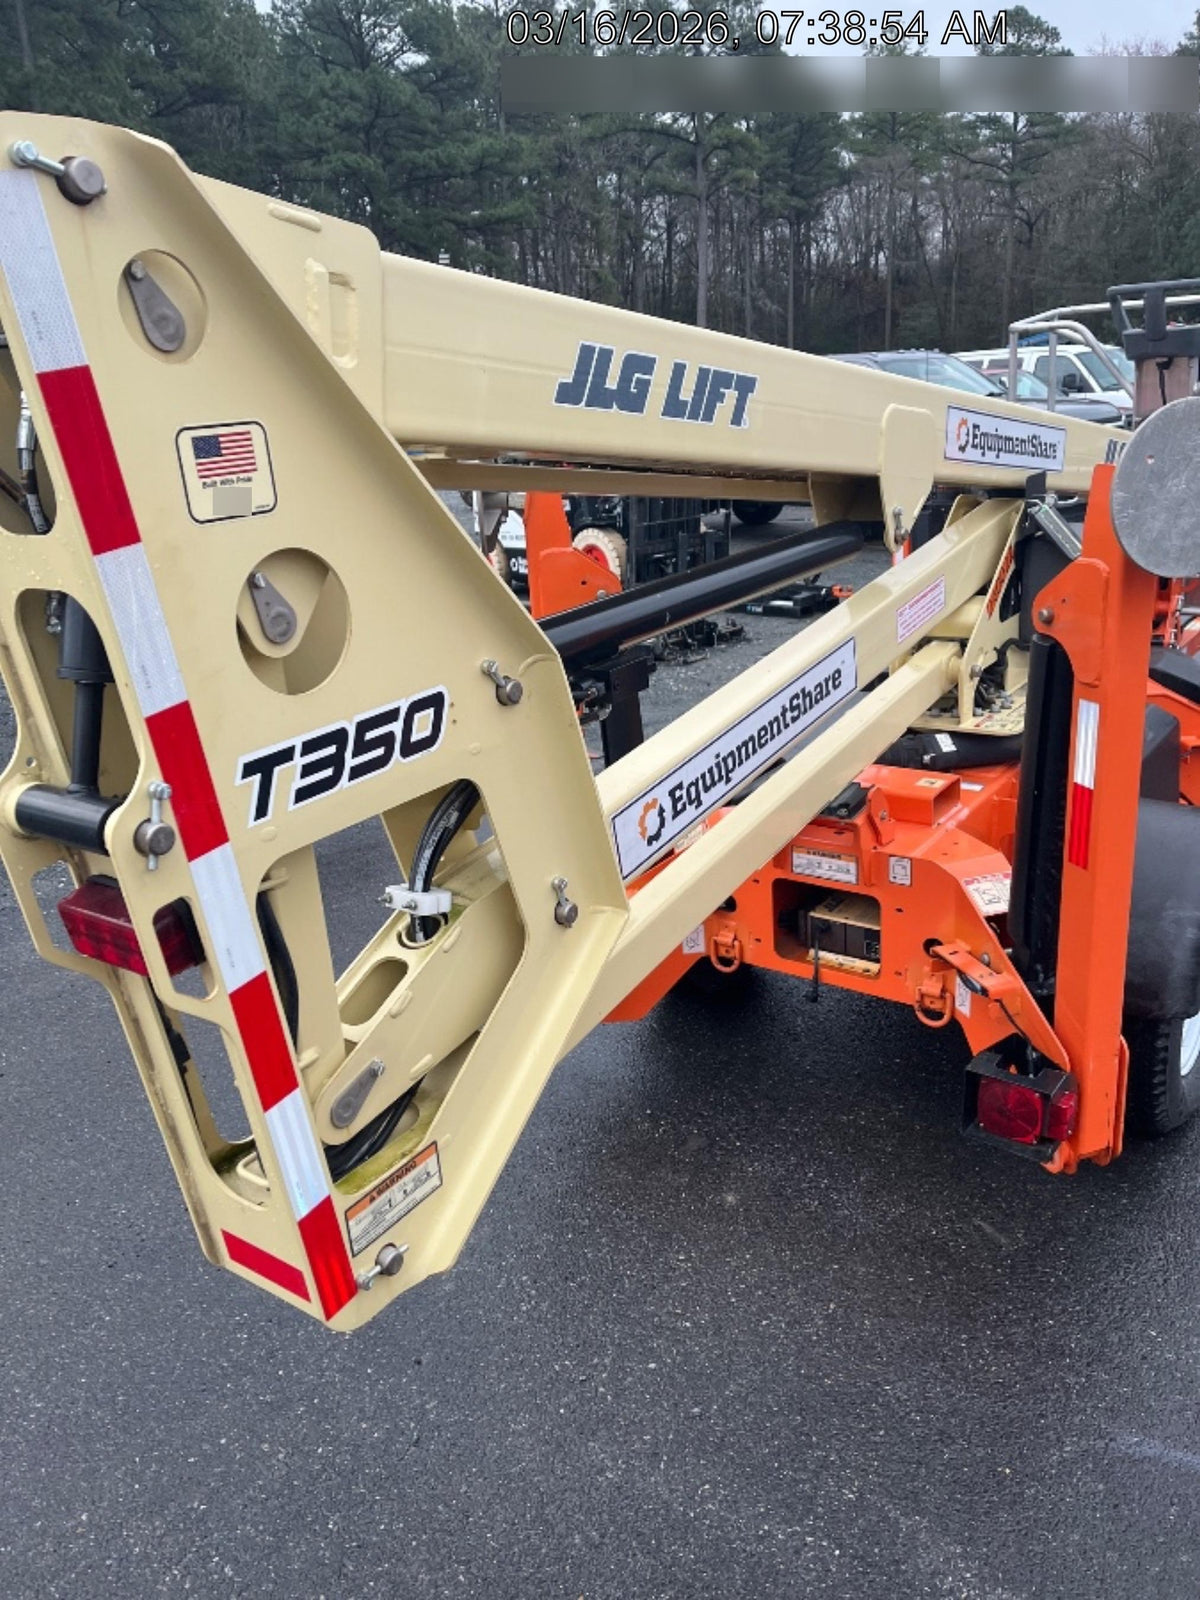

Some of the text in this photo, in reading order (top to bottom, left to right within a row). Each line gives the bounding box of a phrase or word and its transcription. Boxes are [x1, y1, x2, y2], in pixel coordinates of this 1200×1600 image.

[553, 342, 758, 428] JLG LIFT
[970, 422, 1057, 460] EquipmentShare
[239, 688, 447, 825] T350
[668, 667, 842, 821] EquipmentShare
